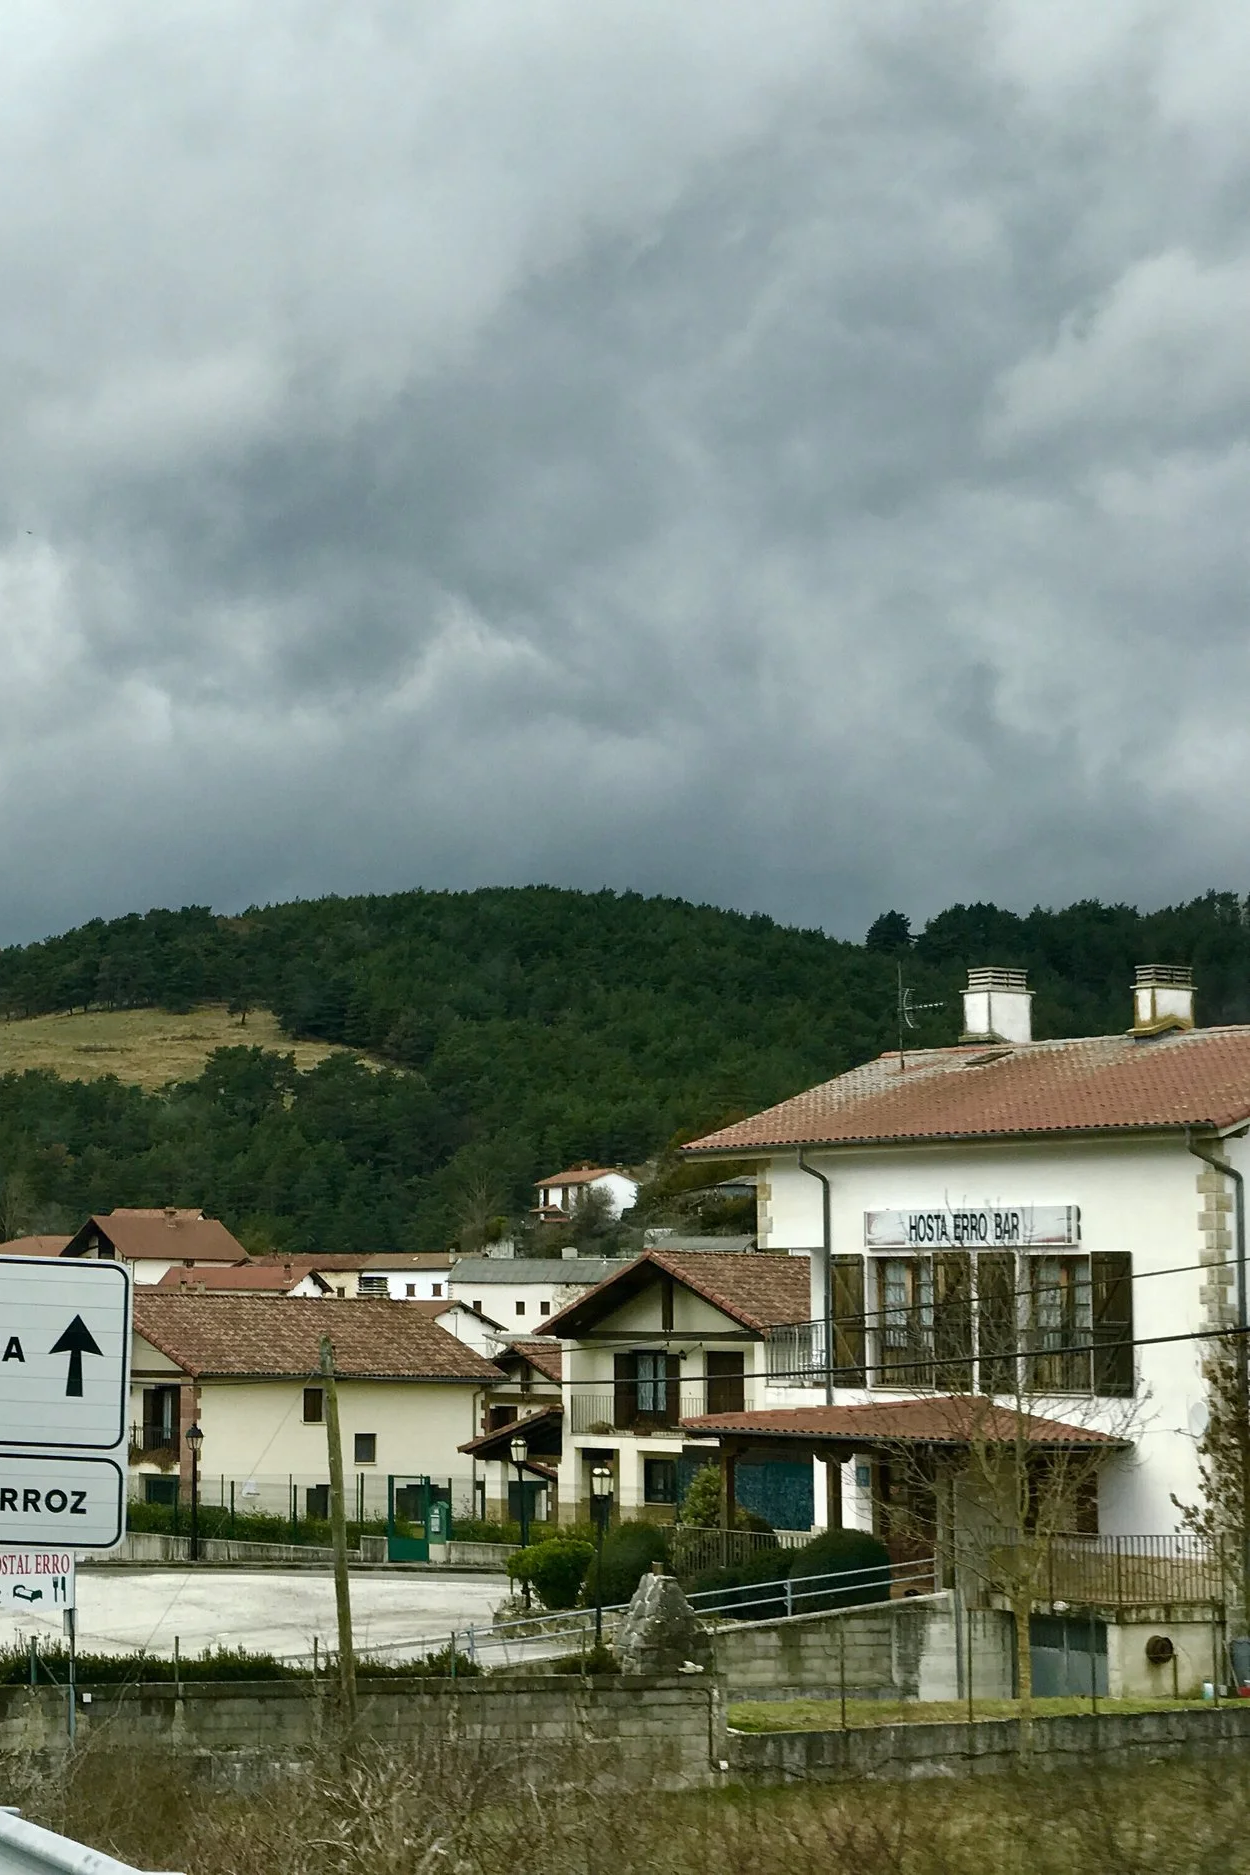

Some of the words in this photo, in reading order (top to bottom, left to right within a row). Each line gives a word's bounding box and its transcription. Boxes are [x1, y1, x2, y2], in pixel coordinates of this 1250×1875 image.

[953, 1213, 988, 1241] ERRO
[995, 1212, 1020, 1241] BAR
[34, 1553, 70, 1575] ERRO
